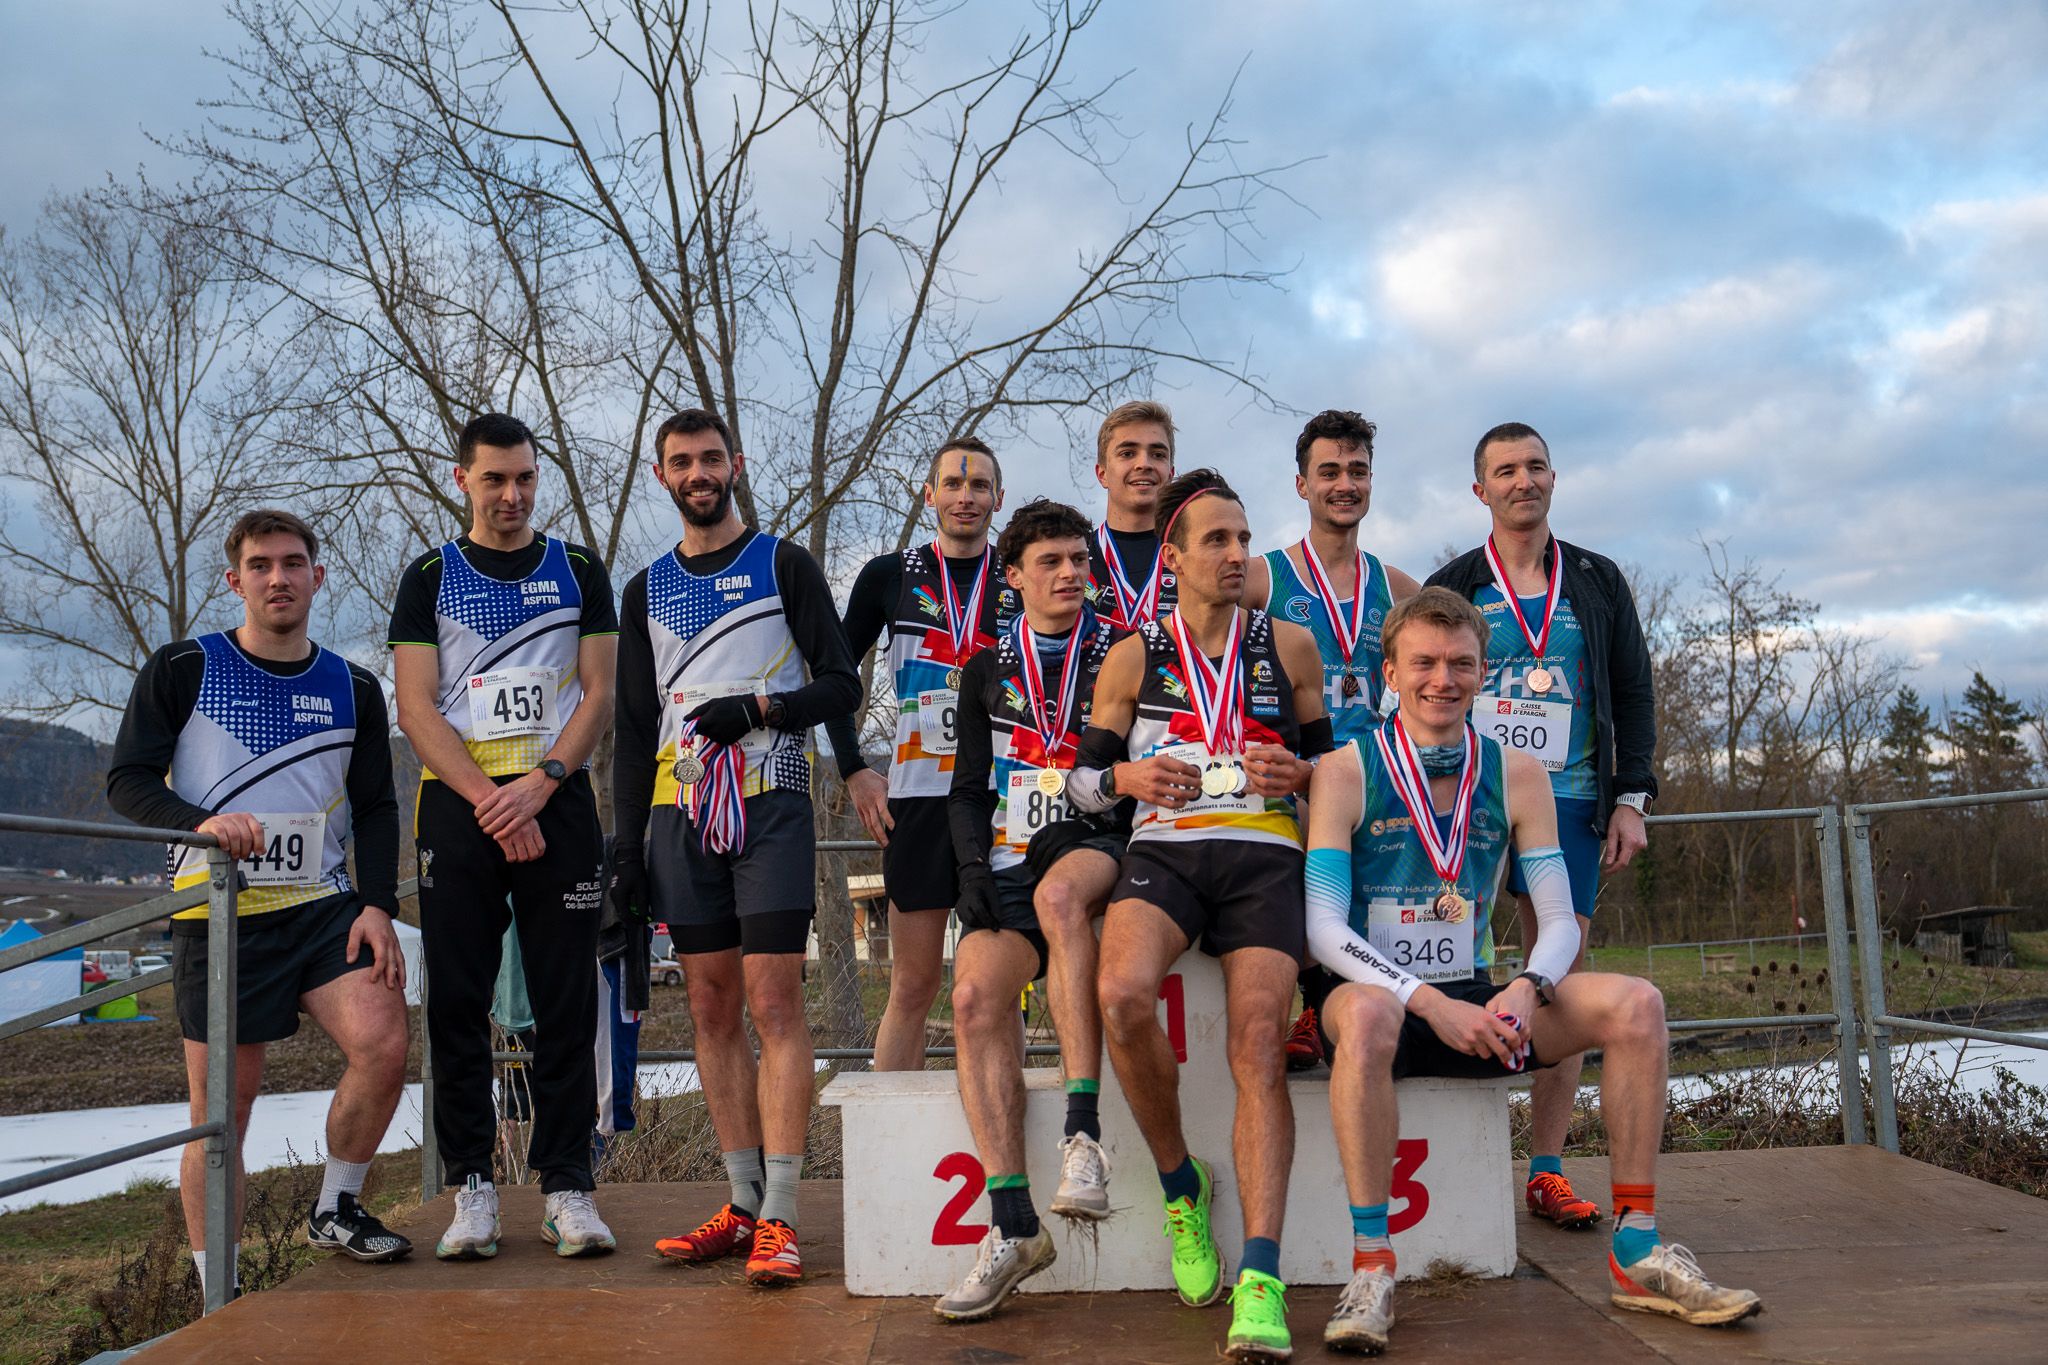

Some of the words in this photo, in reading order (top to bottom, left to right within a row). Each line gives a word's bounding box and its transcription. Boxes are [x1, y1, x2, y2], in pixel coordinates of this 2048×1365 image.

[520, 580, 559, 595] EGMA
[714, 575, 752, 591] EGMA
[523, 595, 560, 606] ASPTTM
[291, 694, 333, 713] EGMA
[493, 684, 543, 724] 453
[1520, 702, 1542, 710] CAISSE
[294, 711, 333, 725] ASPTTM
[1512, 709, 1547, 718] D'EPARGNE
[941, 706, 958, 743] 9
[1493, 723, 1548, 750] 360
[1173, 803, 1218, 815] Championnats
[1362, 885, 1403, 893] Entente
[1405, 885, 1435, 893] Haute
[1394, 937, 1454, 967] 346
[1344, 941, 1401, 980] SCARPA
[1423, 970, 1450, 979] Haut-Rhin
[1387, 1139, 1429, 1234] 3
[931, 1152, 989, 1245] 2
